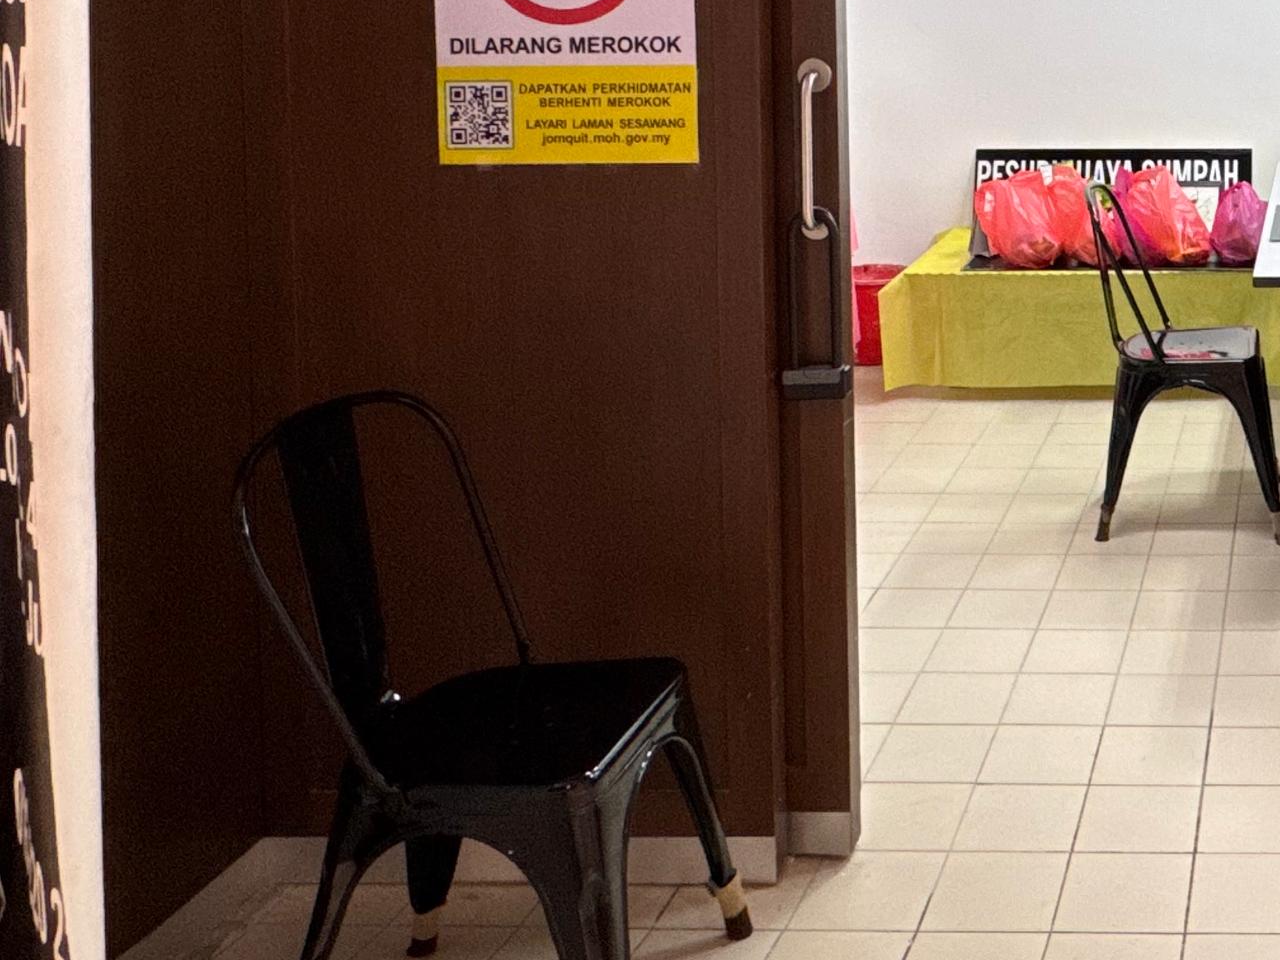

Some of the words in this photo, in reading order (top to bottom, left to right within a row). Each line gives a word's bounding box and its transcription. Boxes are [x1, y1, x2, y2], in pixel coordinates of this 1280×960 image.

[450, 37, 562, 55] DILARANG
[569, 36, 681, 54] MEROKOK
[519, 83, 587, 94] DAPATKAN
[592, 82, 691, 94] PERKHIDMATAN
[539, 97, 601, 108] BERHENTI
[607, 96, 671, 107] MEROKOK
[526, 119, 567, 130] LAYARI
[572, 119, 613, 129] LAMAN
[619, 118, 686, 129] SESAWANG
